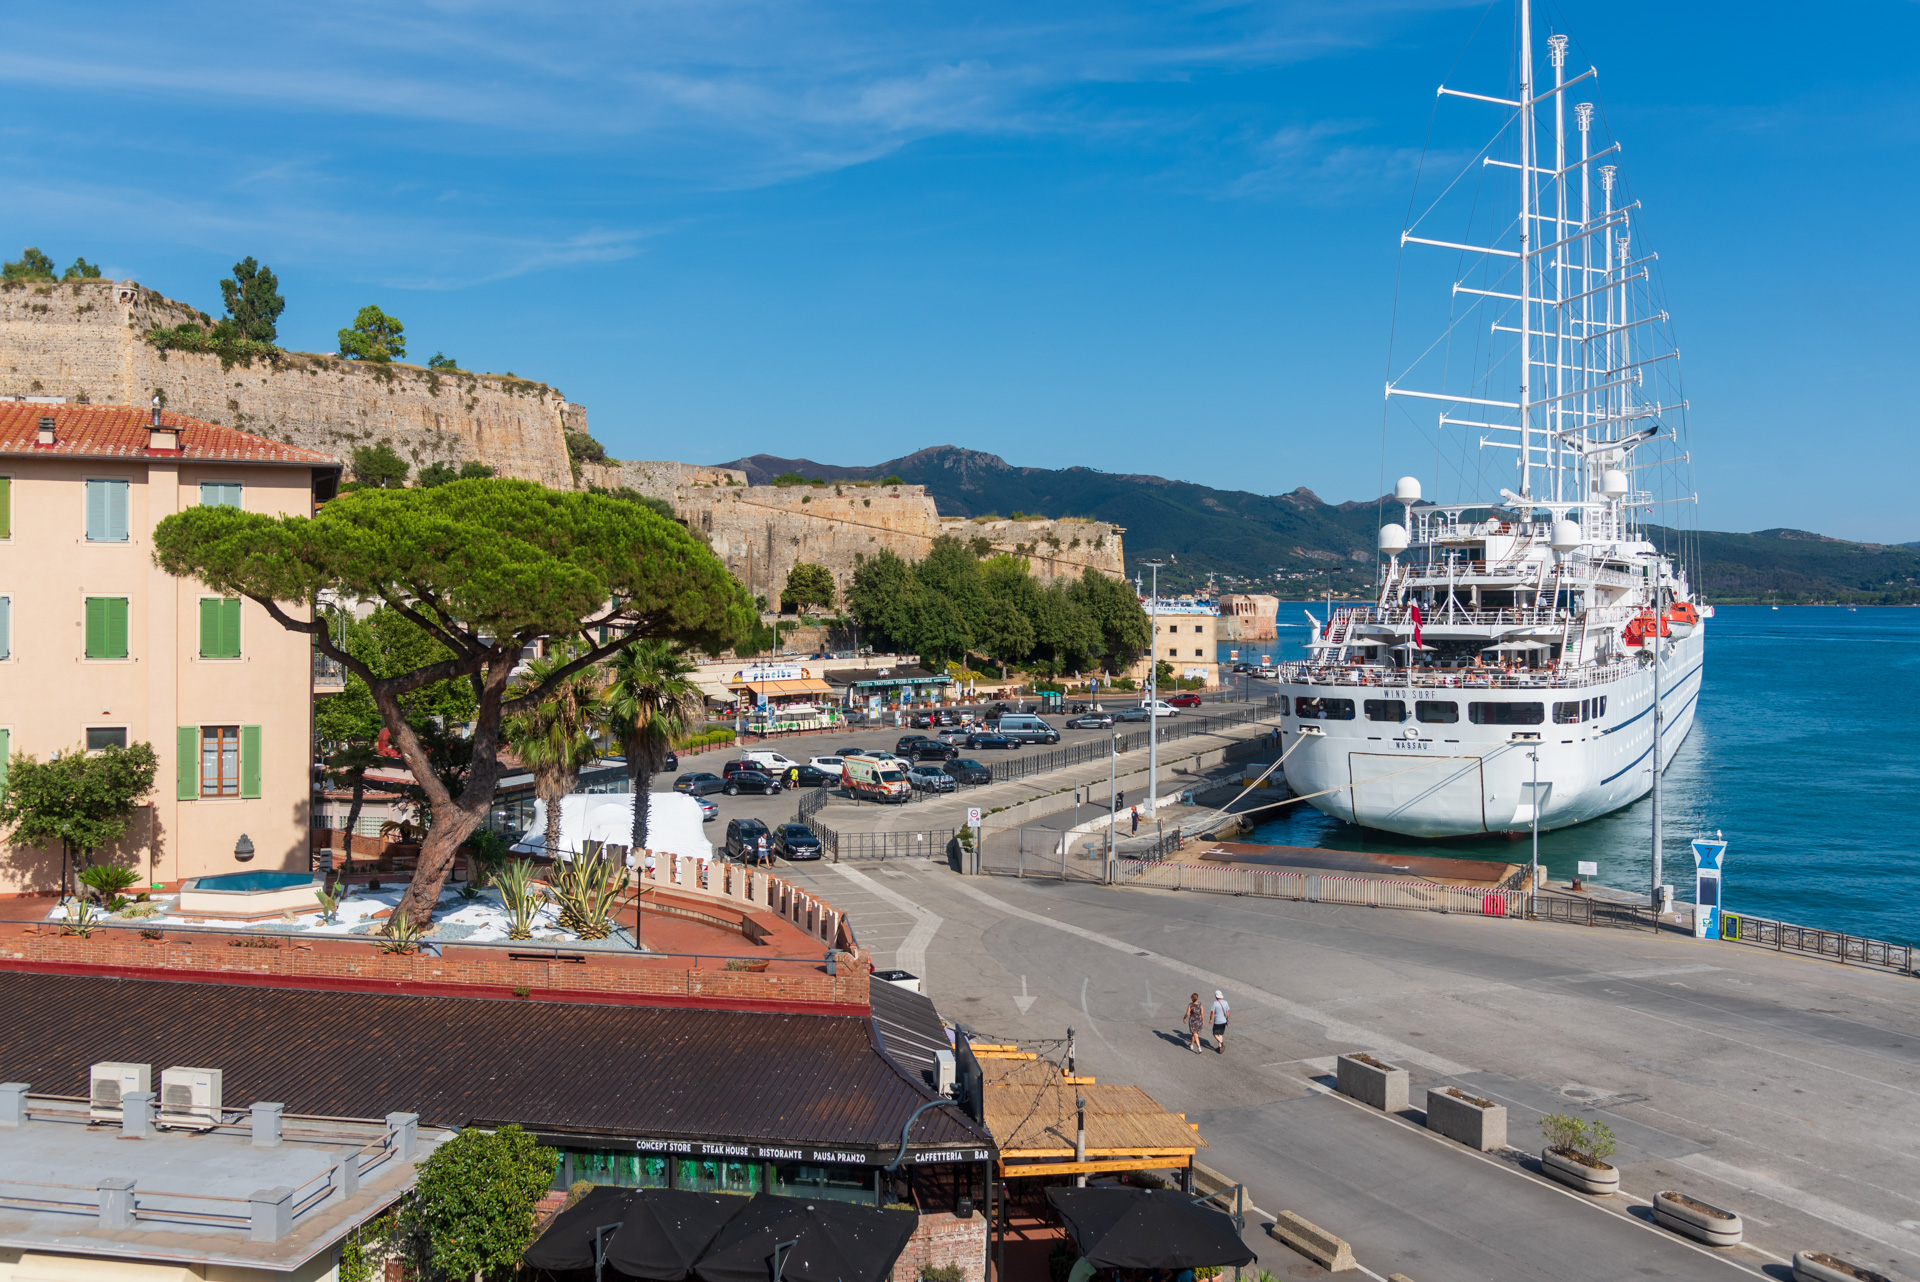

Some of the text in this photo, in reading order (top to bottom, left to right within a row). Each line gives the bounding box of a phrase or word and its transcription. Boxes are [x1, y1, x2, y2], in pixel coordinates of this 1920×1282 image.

[1384, 690, 1436, 699] WIND SURF
[1705, 847, 1713, 858] 7
[636, 1141, 866, 1163] CONCEPT STORE STEAK HOUSE RISTORANTE PAUSA PRANZO
[915, 1151, 989, 1162] CAFFETTERIA BAR
